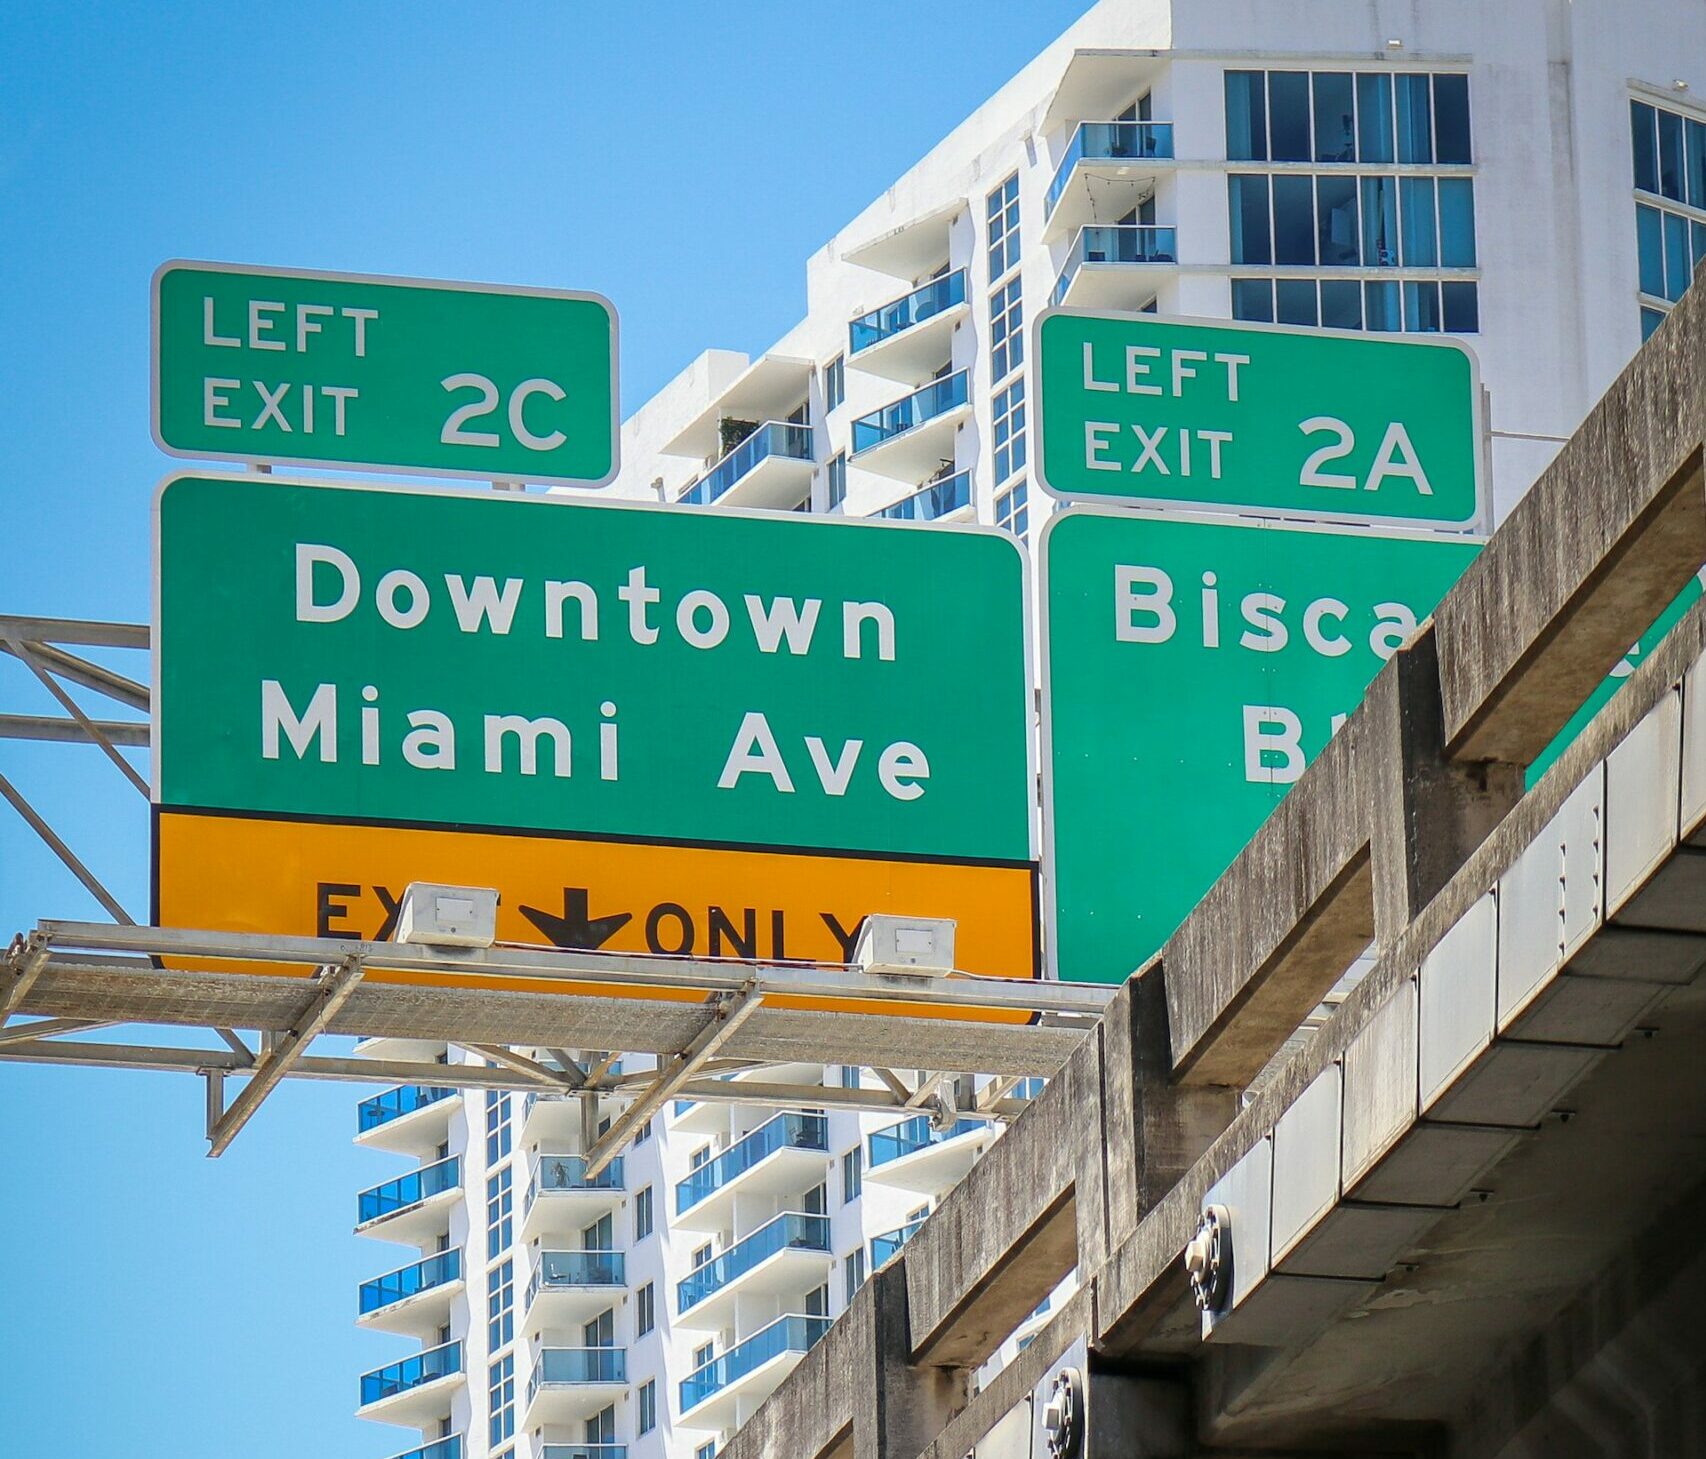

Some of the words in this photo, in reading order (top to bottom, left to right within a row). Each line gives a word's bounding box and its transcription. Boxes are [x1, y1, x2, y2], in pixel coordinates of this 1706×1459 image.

[204, 297, 379, 357] LEFT
[1082, 341, 1250, 402] LEFT
[204, 376, 359, 436] EXIT
[440, 373, 568, 451] 2C
[1084, 420, 1233, 479] EXIT
[1298, 416, 1434, 496] 2A
[295, 543, 896, 661] Downtown
[1113, 564, 1418, 661] Bisca
[261, 680, 619, 781] Miami
[717, 712, 931, 801] Ave
[1242, 704, 1347, 784] B
[645, 902, 869, 970] ONLY
